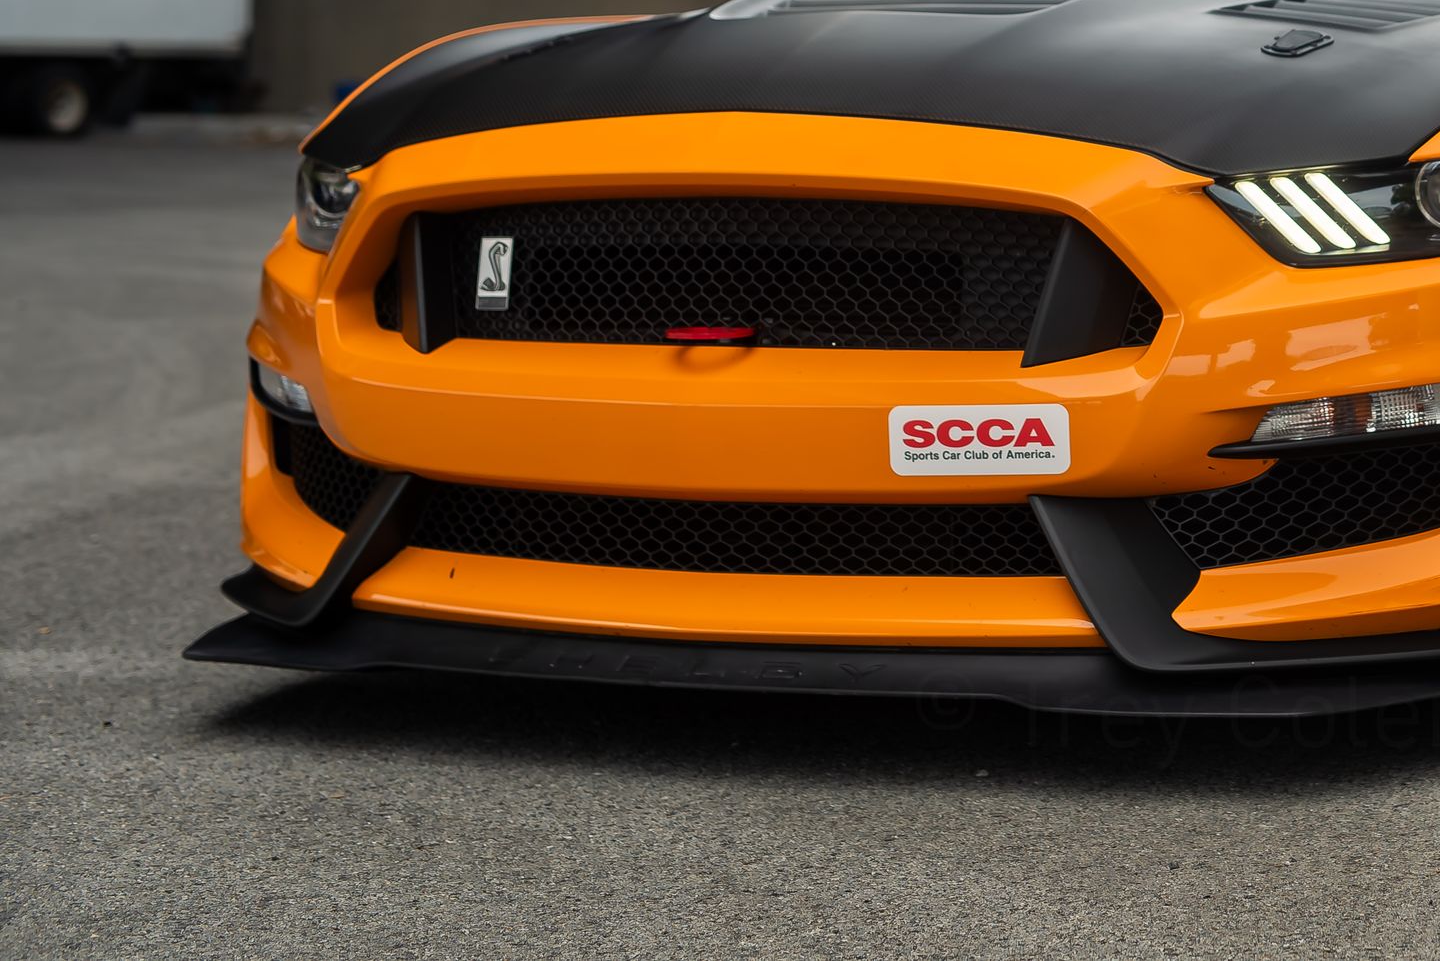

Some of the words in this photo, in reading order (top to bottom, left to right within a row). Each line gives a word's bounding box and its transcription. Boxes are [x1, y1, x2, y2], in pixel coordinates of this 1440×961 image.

[902, 418, 1056, 449] SCCA
[904, 450, 940, 463] Sports
[942, 450, 960, 460] Car
[963, 450, 989, 460] Club
[992, 449, 1003, 460] of
[1006, 449, 1056, 460] America.
